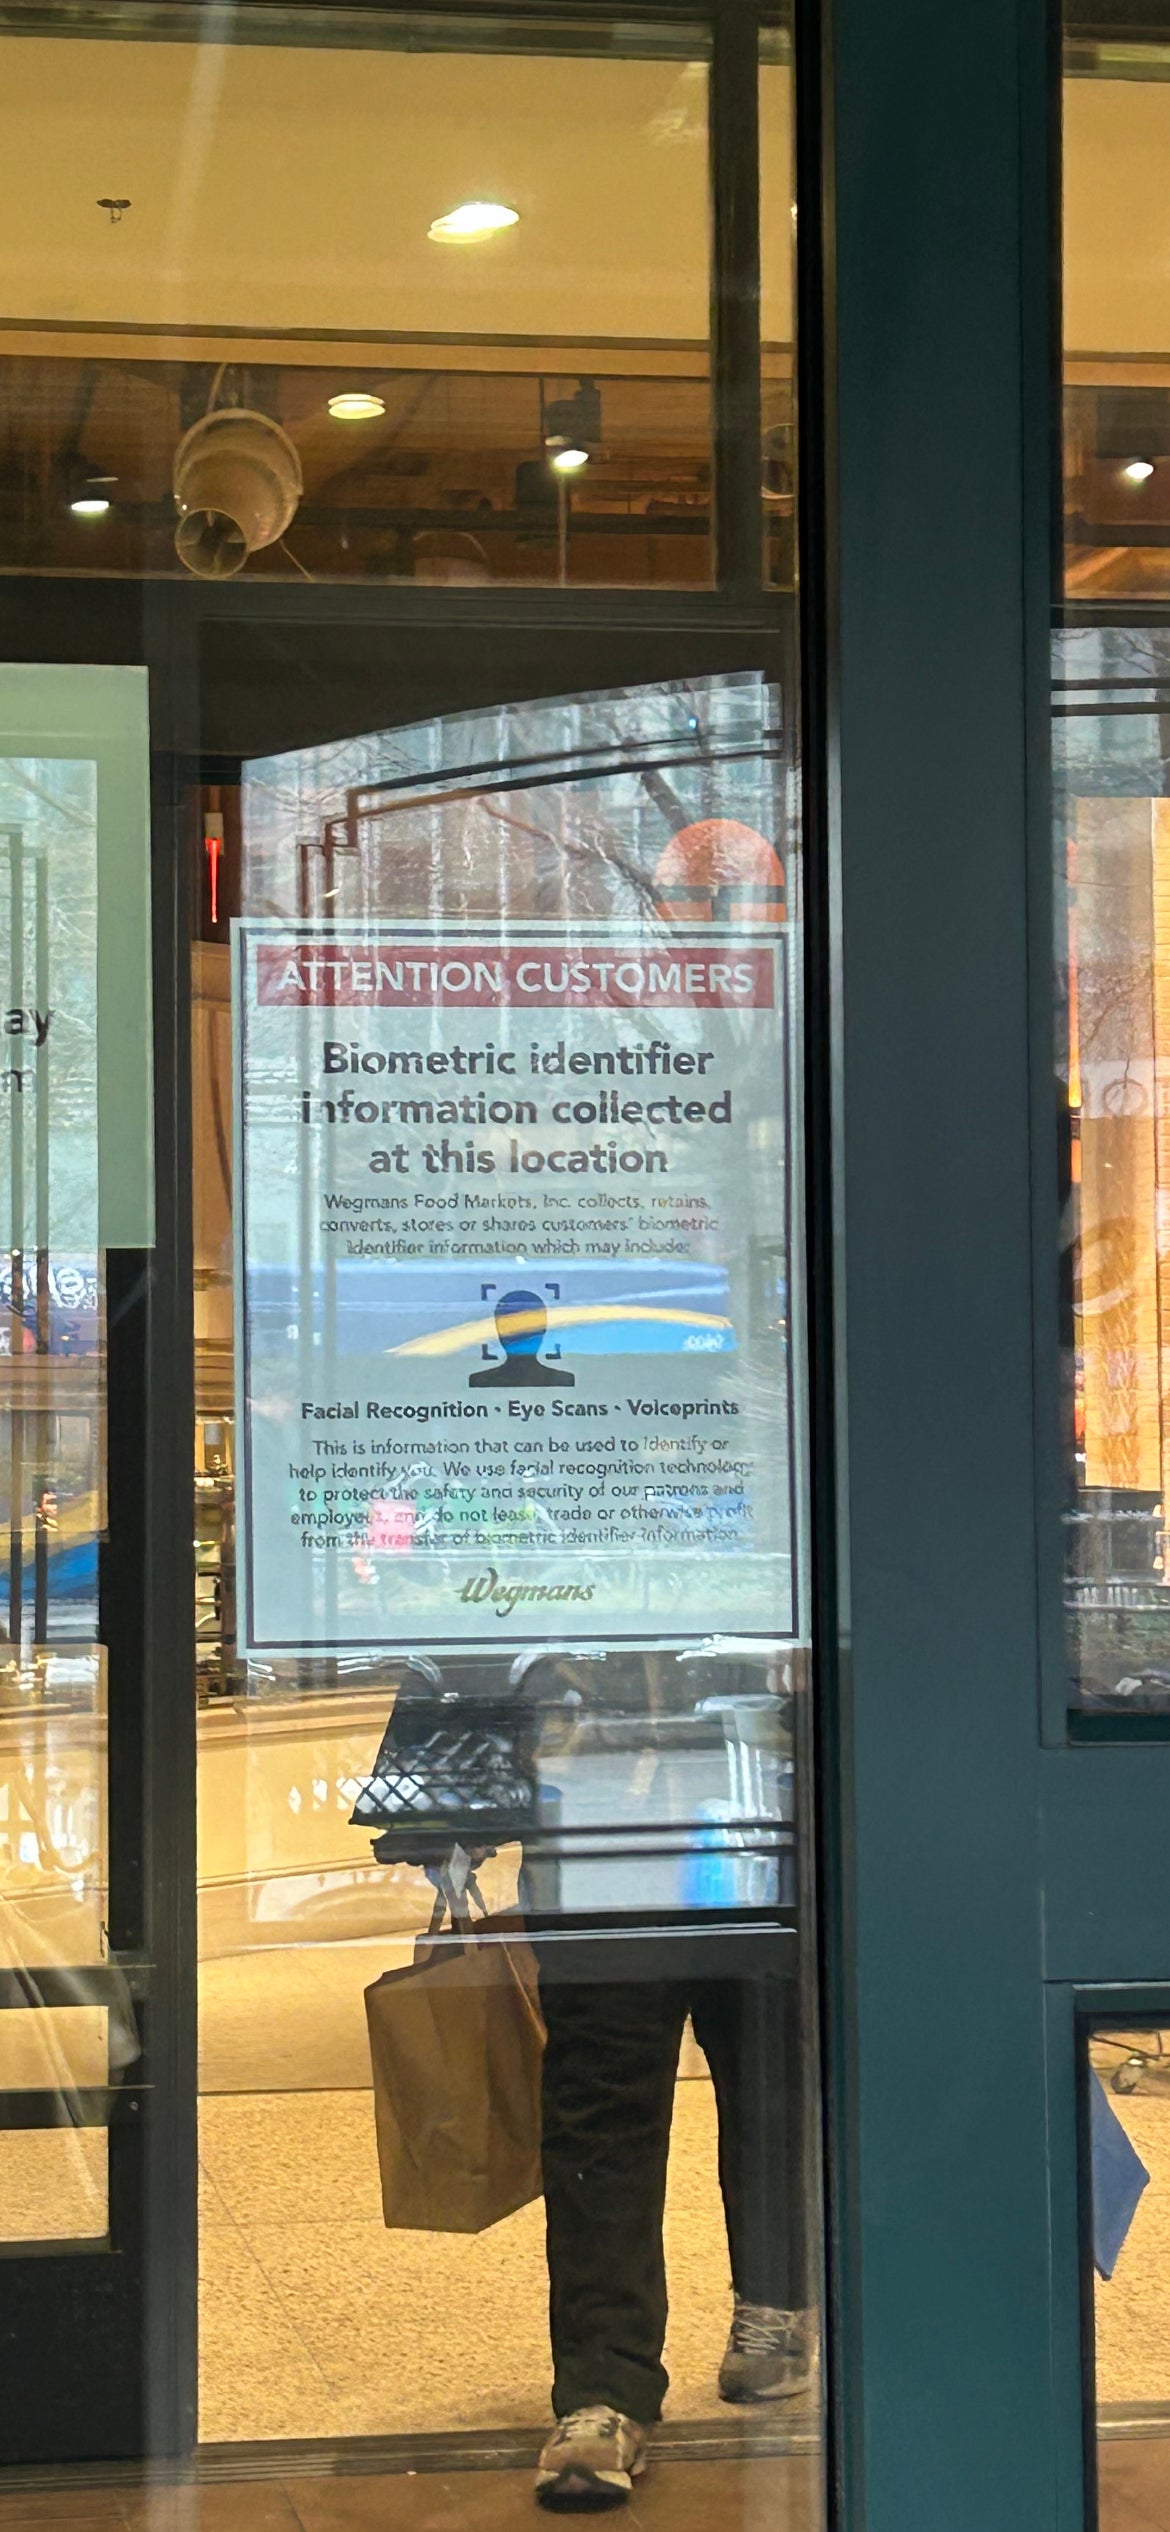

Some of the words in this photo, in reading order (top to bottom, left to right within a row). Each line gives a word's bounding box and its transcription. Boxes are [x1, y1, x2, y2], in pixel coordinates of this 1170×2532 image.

[278, 961, 502, 992] ATTENTION
[516, 962, 753, 993] CUSTOMERS
[323, 1042, 516, 1074] Biometric
[530, 1040, 714, 1075] identifier
[303, 1089, 537, 1124] information
[552, 1090, 732, 1124] collected
[369, 1144, 409, 1173] at
[422, 1138, 496, 1173] this
[510, 1138, 668, 1174] location
[324, 1194, 408, 1213] Wegmans
[414, 1193, 458, 1209] Food
[465, 1193, 537, 1209] Markets,
[320, 1217, 397, 1233] converts,
[402, 1217, 454, 1233] stores
[459, 1219, 475, 1232] or
[483, 1216, 536, 1232] shares
[639, 1215, 719, 1231] biometric
[347, 1239, 424, 1255] identifier
[430, 1239, 527, 1255] information
[532, 1238, 579, 1255] which
[585, 1242, 620, 1257] may
[301, 1401, 359, 1419] Facial
[367, 1401, 488, 1422] Recognition
[508, 1400, 545, 1421] Eye
[552, 1399, 608, 1417] Scans
[626, 1398, 740, 1419] Voiceprints
[313, 1440, 348, 1456] This
[353, 1440, 366, 1455] is
[371, 1438, 470, 1455] information
[475, 1437, 509, 1454] that
[514, 1441, 543, 1453] can
[548, 1436, 569, 1453] be
[576, 1436, 615, 1452] used
[620, 1438, 639, 1452] to
[643, 1434, 707, 1455] identify
[712, 1438, 729, 1450] or
[289, 1463, 326, 1482] help
[332, 1461, 396, 1480] identify
[443, 1460, 470, 1477] We
[476, 1463, 505, 1477] use
[511, 1459, 553, 1477] facial
[559, 1458, 655, 1477] recognition
[299, 1486, 317, 1501] to
[323, 1485, 386, 1506] protect
[391, 1484, 418, 1501] the
[424, 1483, 477, 1503] safety
[481, 1482, 513, 1499] and
[517, 1482, 583, 1501] security
[588, 1481, 605, 1497] of
[611, 1484, 640, 1498] our
[713, 1478, 744, 1496] and
[460, 1507, 487, 1523] not
[546, 1504, 592, 1521] trade
[597, 1507, 615, 1521] or
[301, 1531, 342, 1549] from
[454, 1566, 596, 1618] Wegmans
